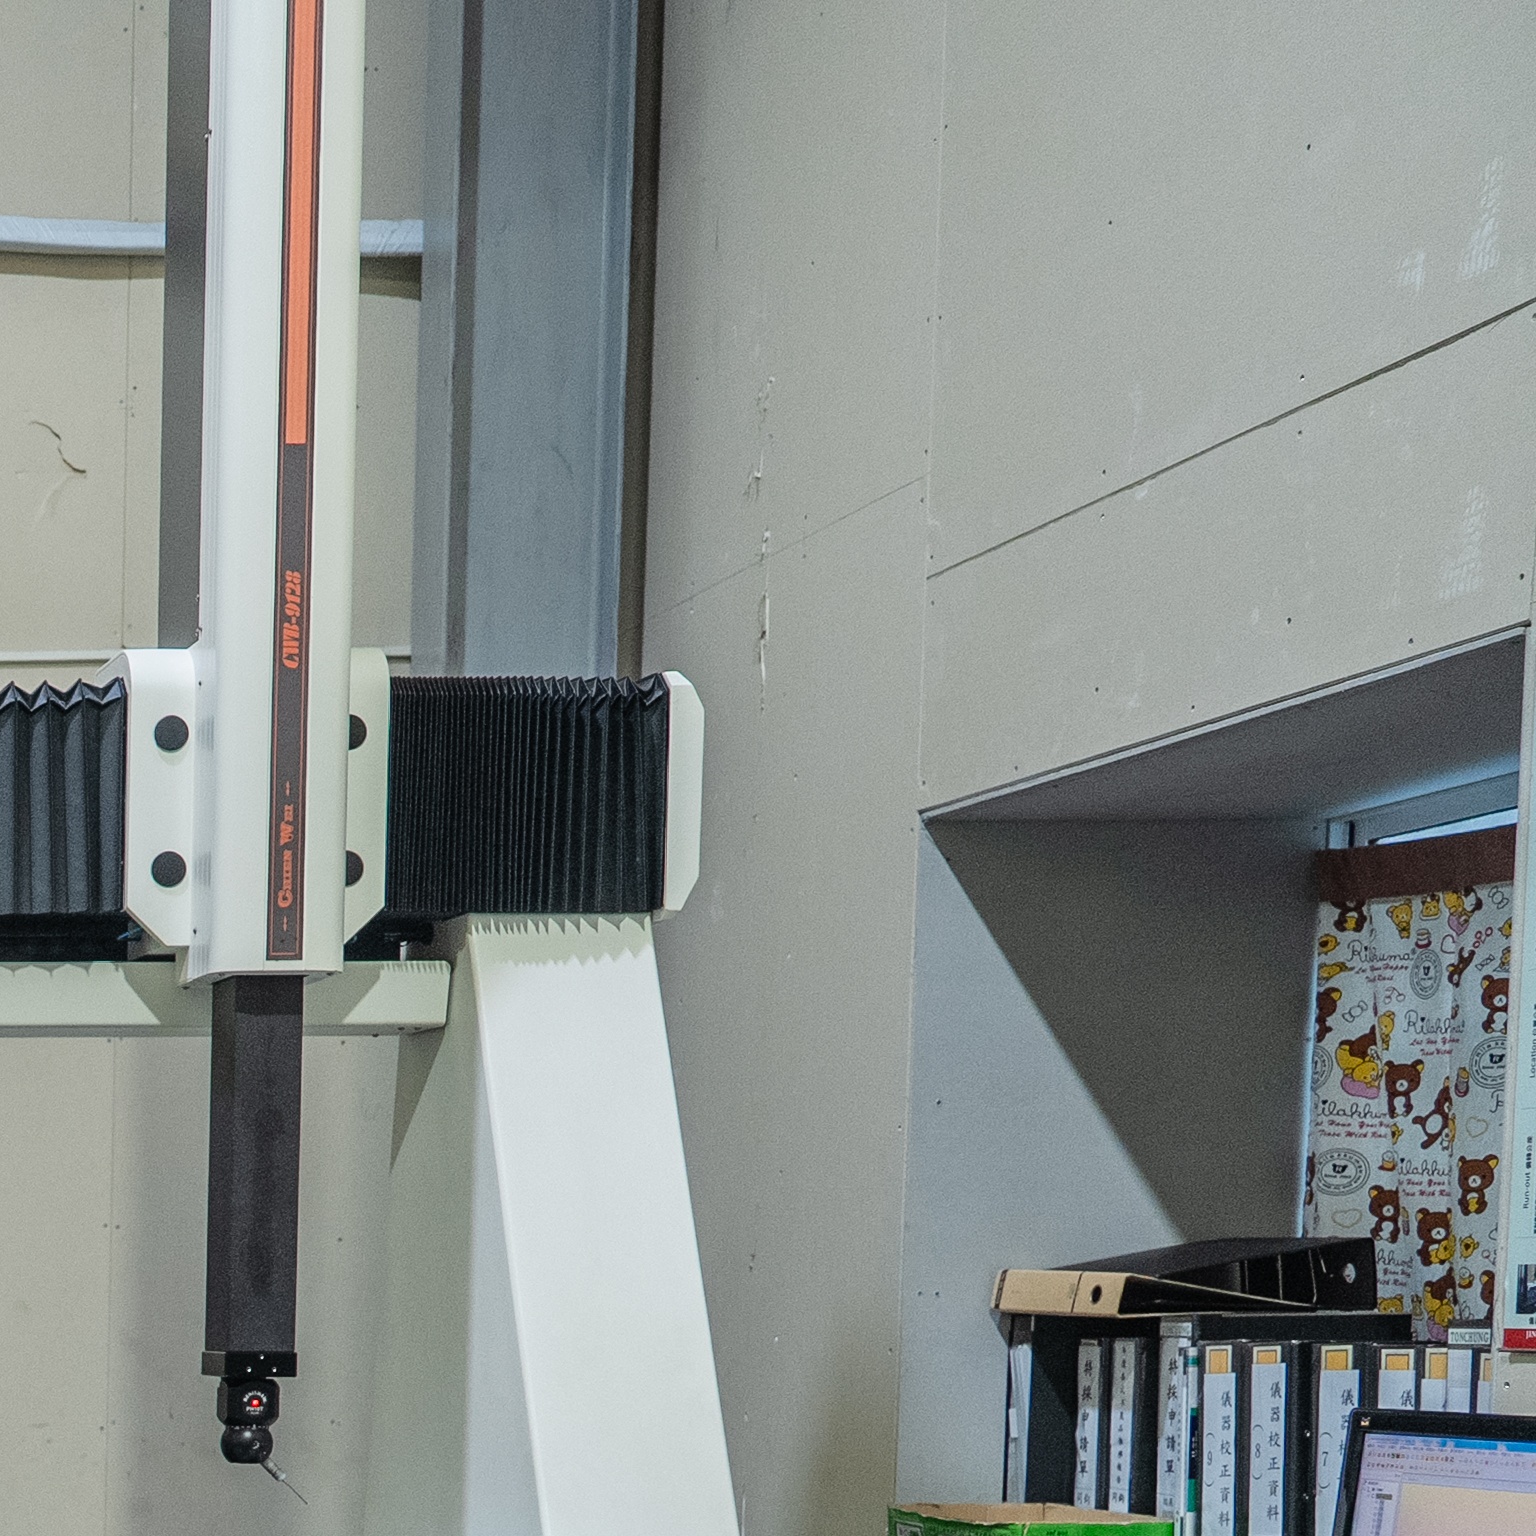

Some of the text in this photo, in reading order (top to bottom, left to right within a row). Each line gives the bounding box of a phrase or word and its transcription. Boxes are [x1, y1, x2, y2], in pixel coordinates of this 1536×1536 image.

[282, 570, 301, 669] CWB-9128
[1523, 1172, 1531, 1209] Run-out
[1450, 1332, 1488, 1343] TONCHUNG
[1218, 1390, 1233, 1528] 儀器校正資料
[1266, 1381, 1282, 1522] 儀器校正資料
